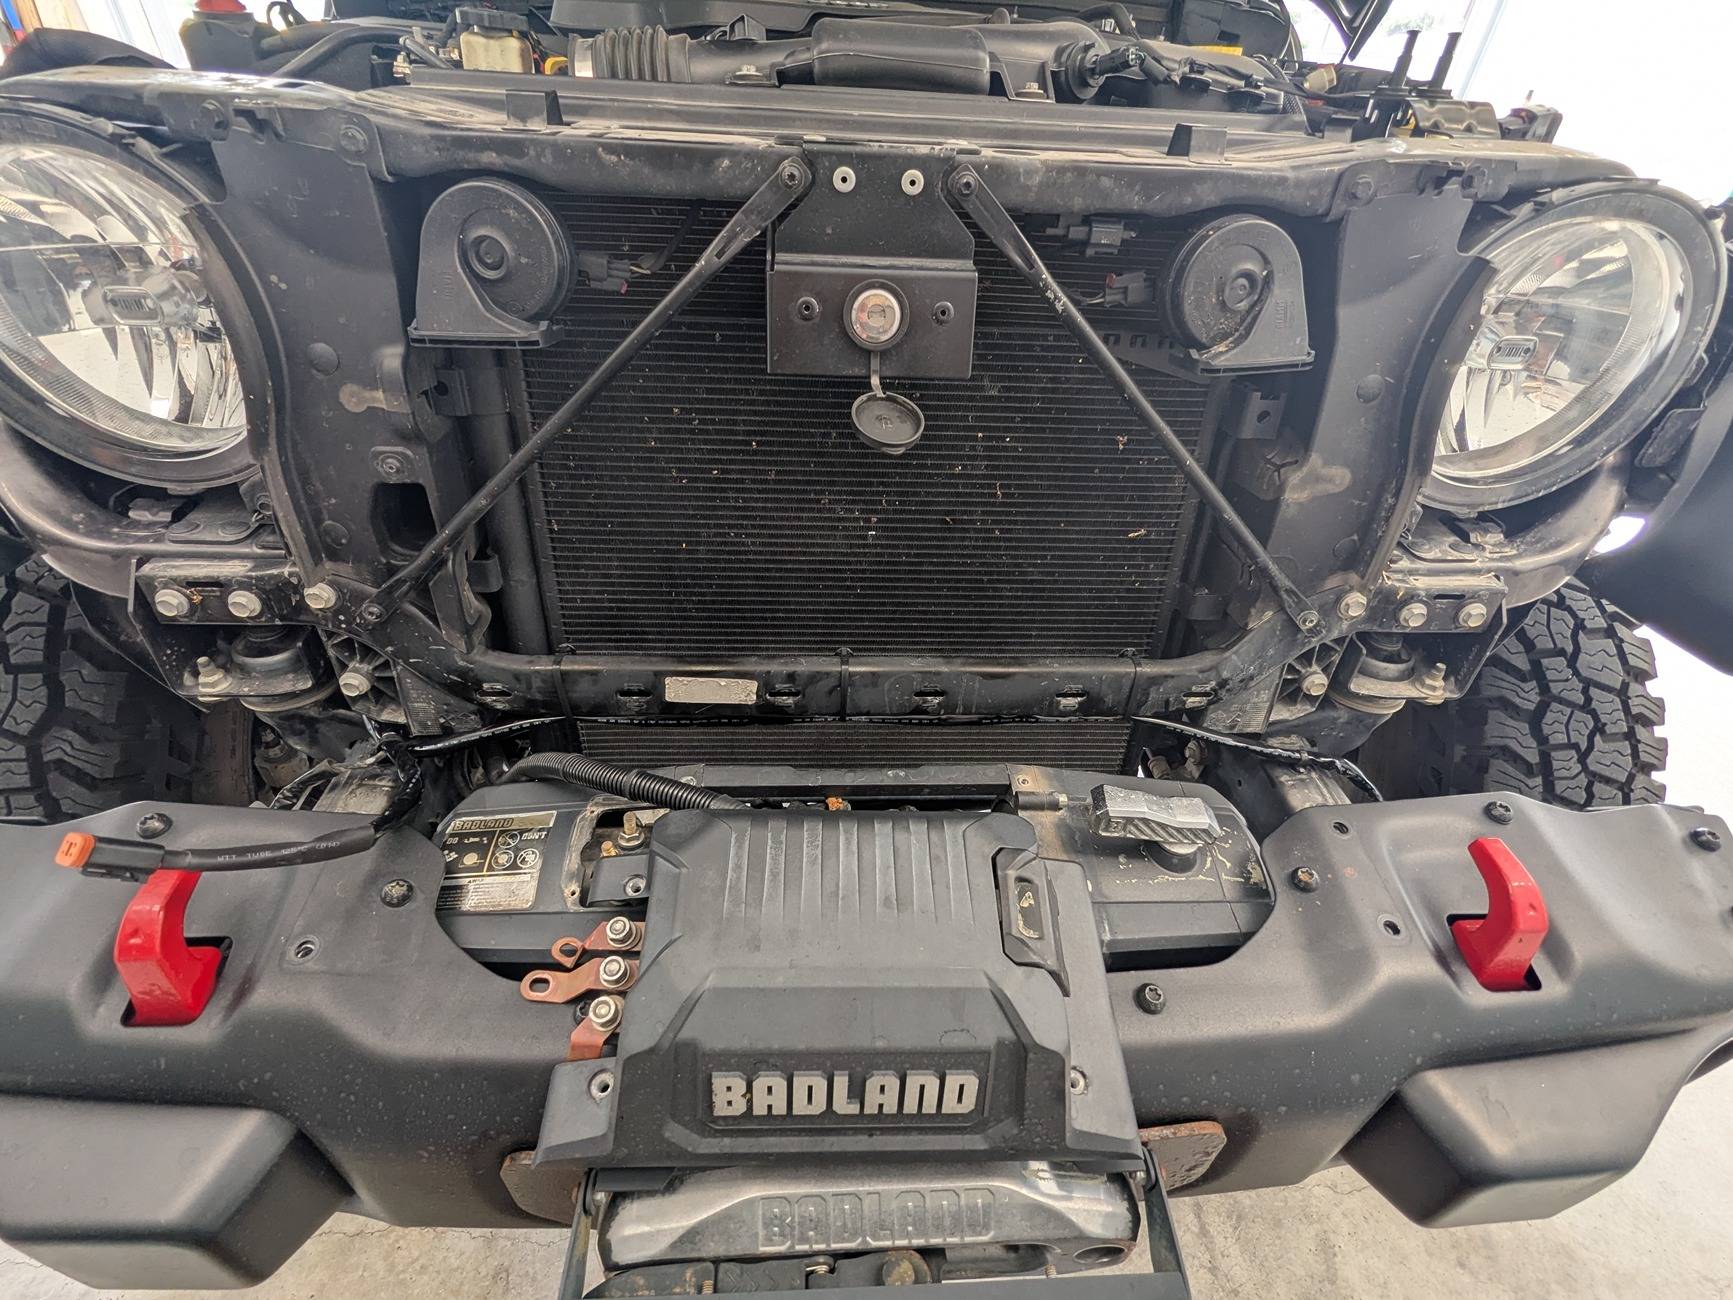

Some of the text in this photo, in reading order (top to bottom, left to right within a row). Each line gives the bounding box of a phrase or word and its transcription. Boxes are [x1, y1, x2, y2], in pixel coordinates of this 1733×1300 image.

[452, 818, 514, 831] BADLAND
[521, 832, 547, 840] DON'T
[711, 1070, 980, 1117] BADLAND
[759, 1187, 995, 1250] BADLAND
